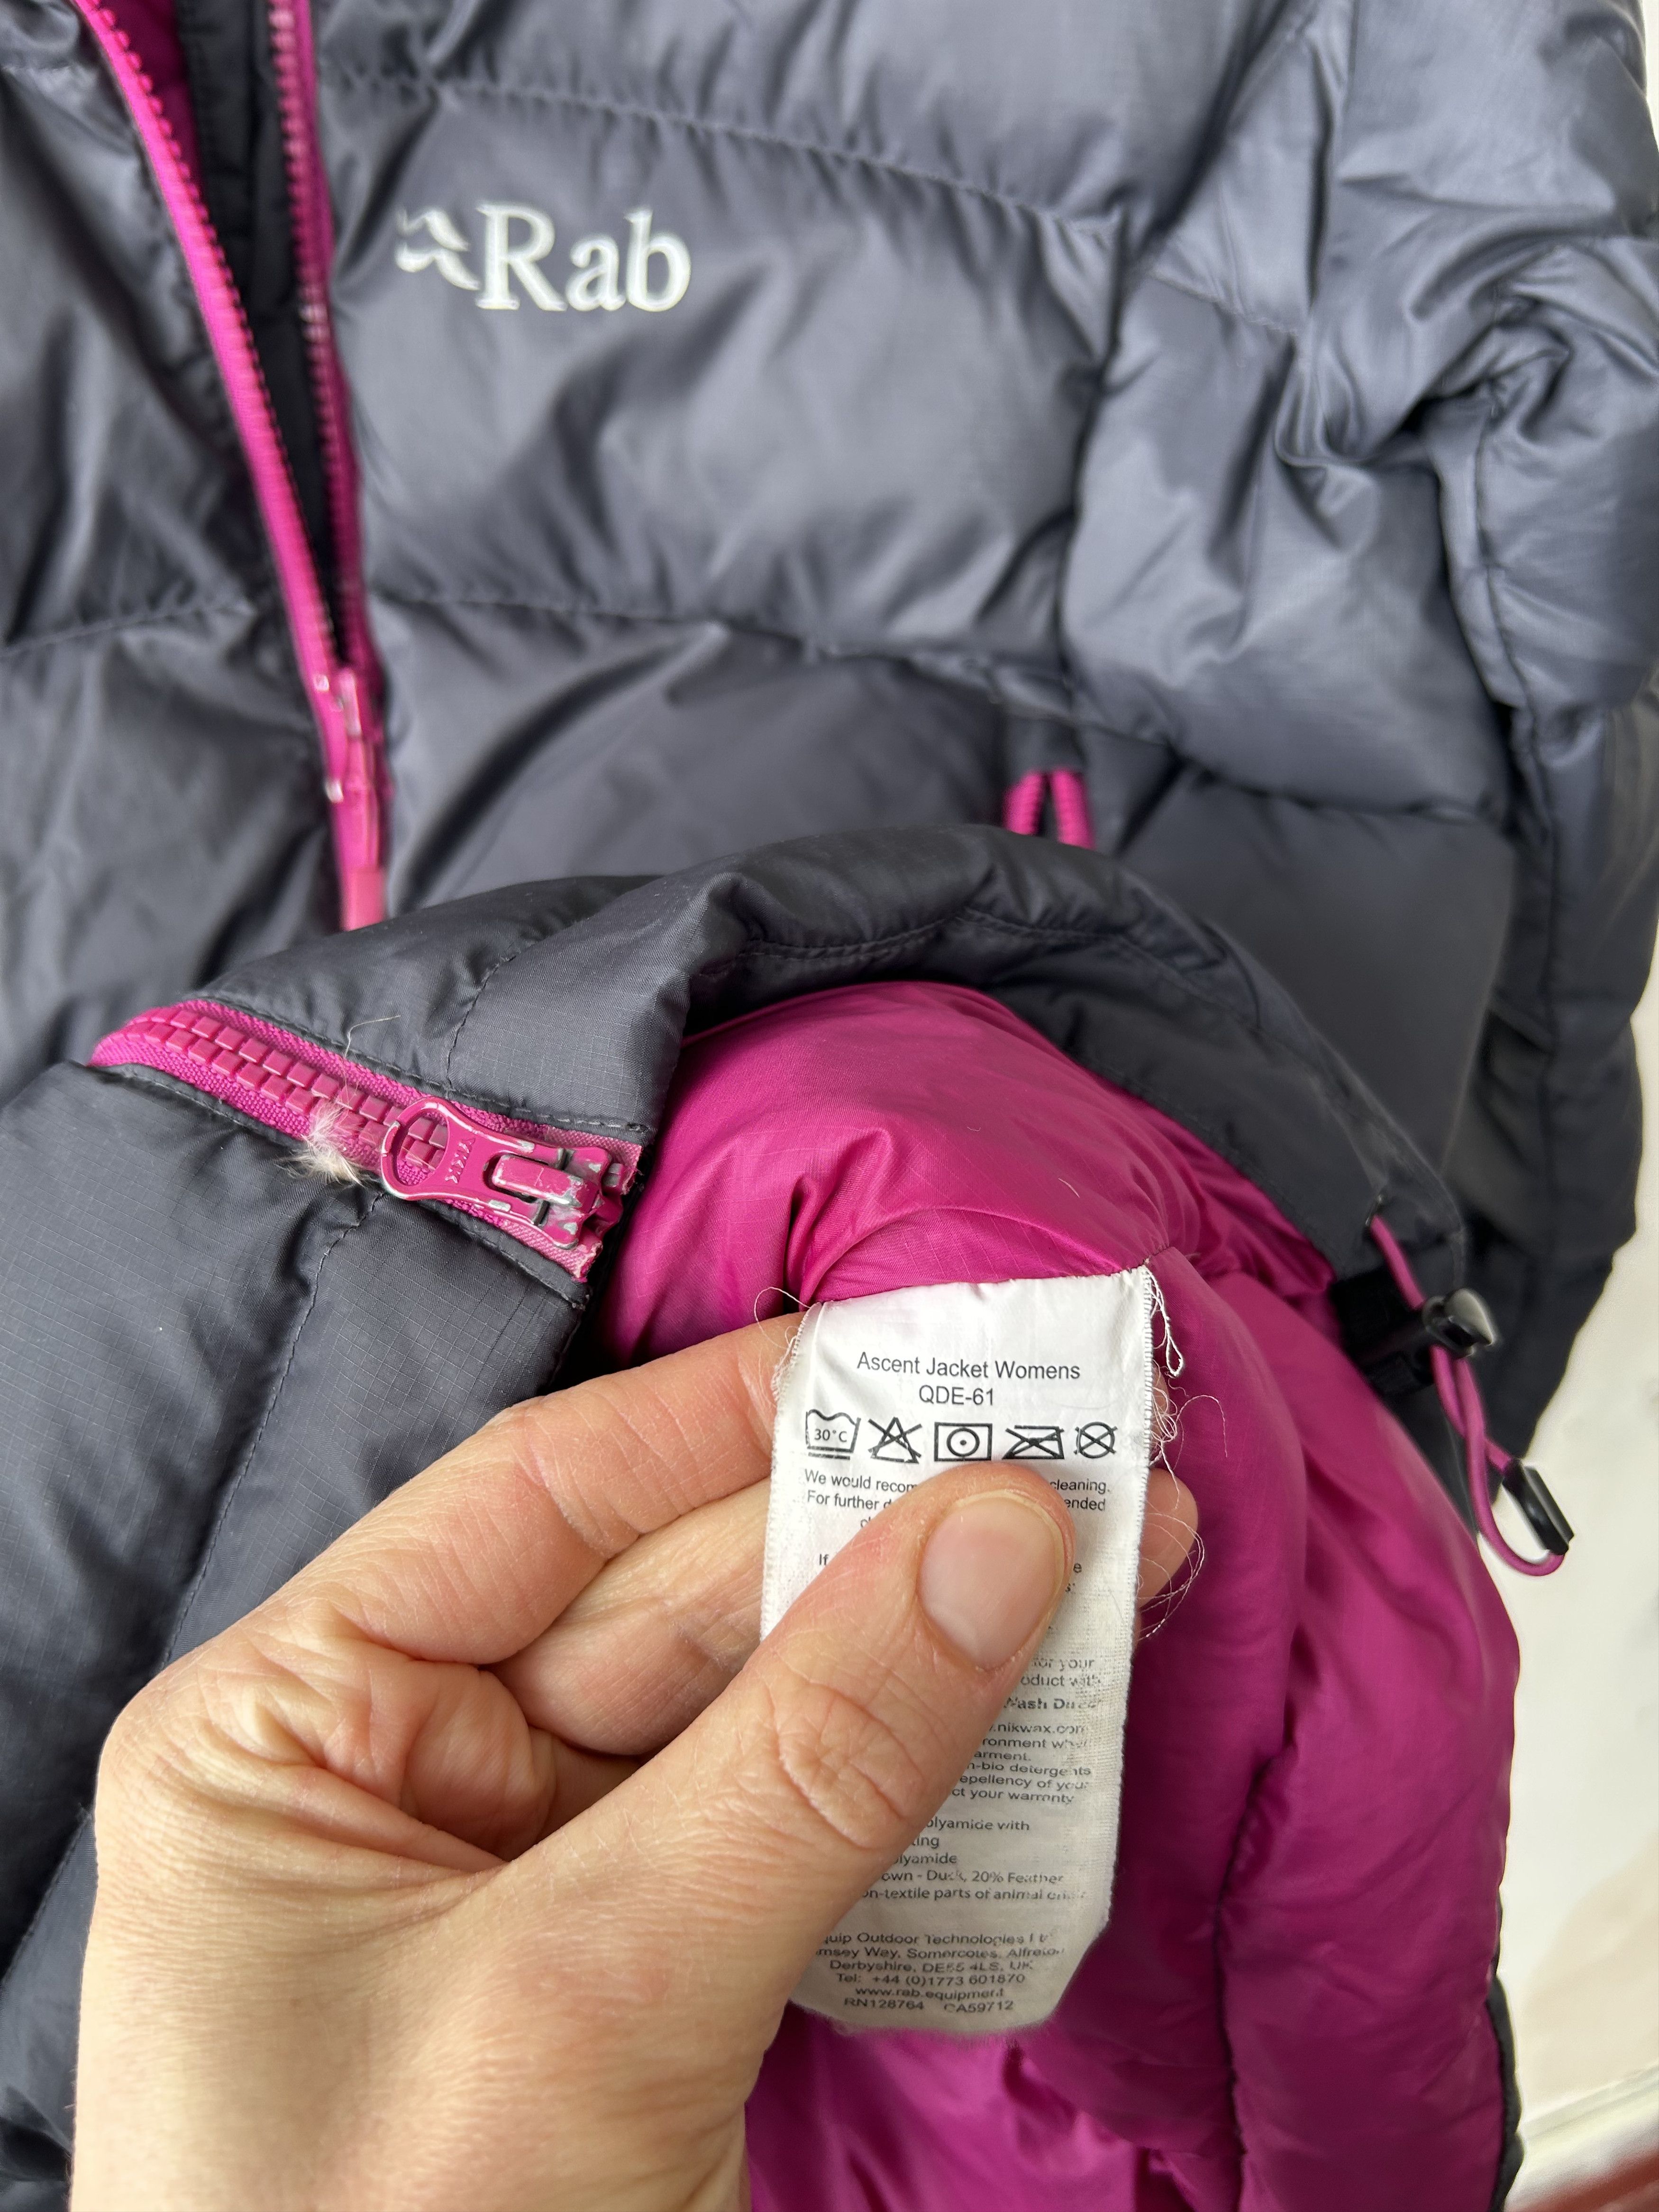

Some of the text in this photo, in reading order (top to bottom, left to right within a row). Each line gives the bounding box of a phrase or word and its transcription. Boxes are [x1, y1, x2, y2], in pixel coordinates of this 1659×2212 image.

[475, 201, 692, 313] Rab
[857, 1351, 1081, 1379] Ascent Jacket Womens
[919, 1384, 994, 1406] QDE-61
[805, 1468, 826, 1484] We
[831, 1475, 871, 1489] would
[1049, 1478, 1111, 1494] cleaning.
[807, 1489, 830, 1505] For
[834, 1493, 879, 1510] further
[1059, 1658, 1095, 1672] your
[1021, 1674, 1065, 1687] oduct
[982, 1738, 1047, 1748] ronment
[974, 1750, 1031, 1761] arment.
[960, 1774, 1032, 1789] epellency
[1037, 1779, 1052, 1788] of
[970, 1789, 1004, 1800] your
[927, 1816, 1030, 1835] olyamide with
[881, 1871, 913, 1882] own
[972, 1870, 1004, 1883] 20%
[1008, 1872, 1063, 1884] Feather
[863, 1886, 930, 1901] on-textile
[934, 1887, 971, 1902] parts
[975, 1887, 992, 1900] of
[994, 1888, 1042, 1901] animal
[857, 1932, 918, 1944] Outdoor
[925, 1934, 1025, 1947] Technologies
[837, 1972, 1025, 1987] Tel: +44 (0)1773 601870
[844, 1997, 1014, 2013] RN128764 CA59712
